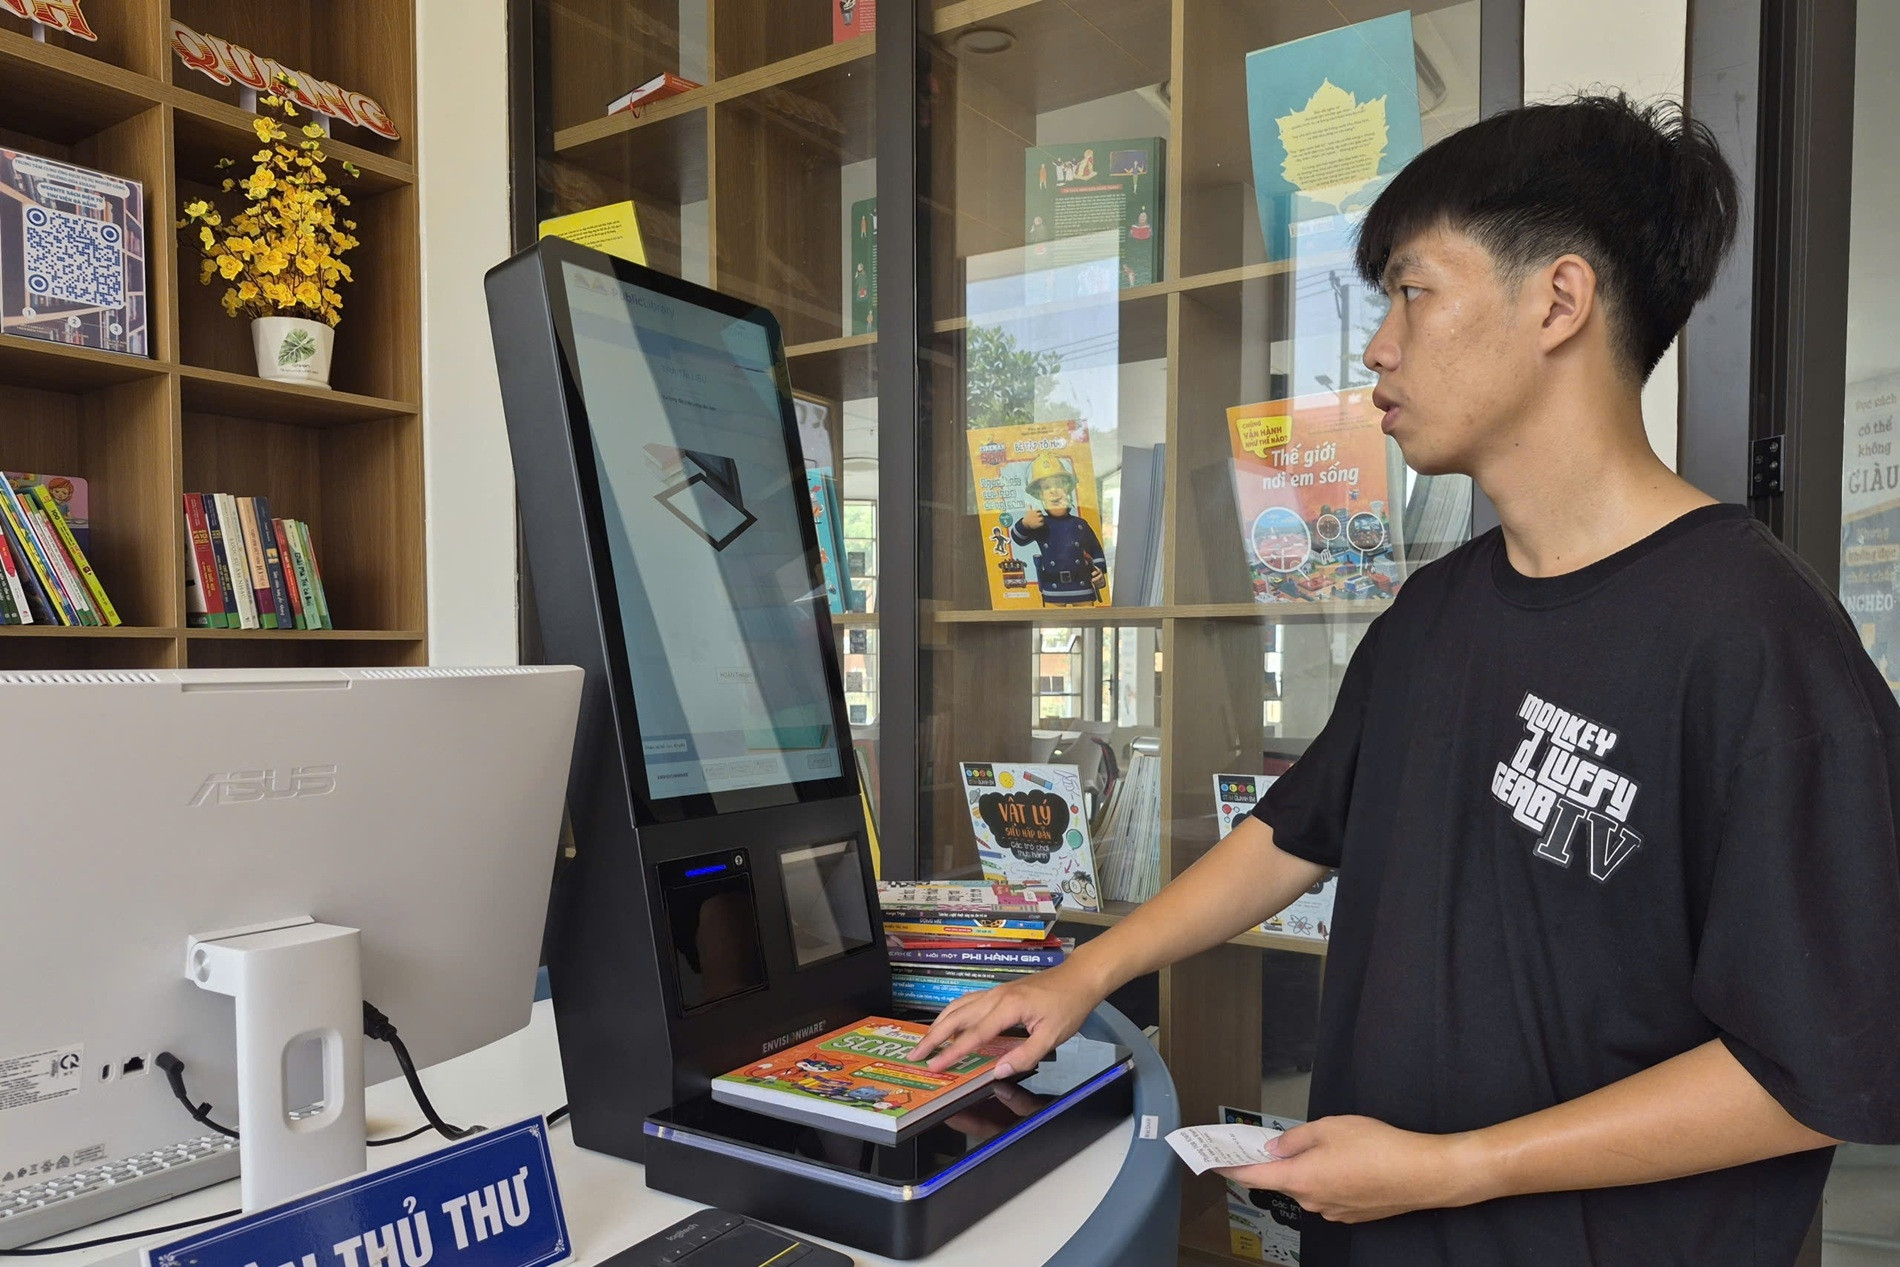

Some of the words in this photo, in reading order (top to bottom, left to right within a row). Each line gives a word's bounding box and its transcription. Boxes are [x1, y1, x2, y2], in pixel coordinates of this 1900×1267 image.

[1260, 425, 1282, 436] HÀNH
[1858, 421, 1871, 436] có
[1873, 414, 1893, 435] thể
[1271, 442, 1302, 467] Thế
[1304, 440, 1337, 468] giới
[1858, 440, 1892, 458] không
[1263, 470, 1287, 490] nơi
[1290, 472, 1314, 487] em
[1319, 460, 1360, 486] sống
[1849, 462, 1900, 495] GIÀU
[187, 763, 338, 807] ASUS
[998, 796, 1026, 827] VẬT
[1032, 798, 1052, 826] LÝ
[1491, 761, 1557, 832] GEAR
[1537, 798, 1642, 882] IV
[984, 952, 1019, 962] HÀNH
[1020, 954, 1041, 963] GIA
[333, 1196, 434, 1267] THỦ
[441, 1165, 531, 1250] THƯ
